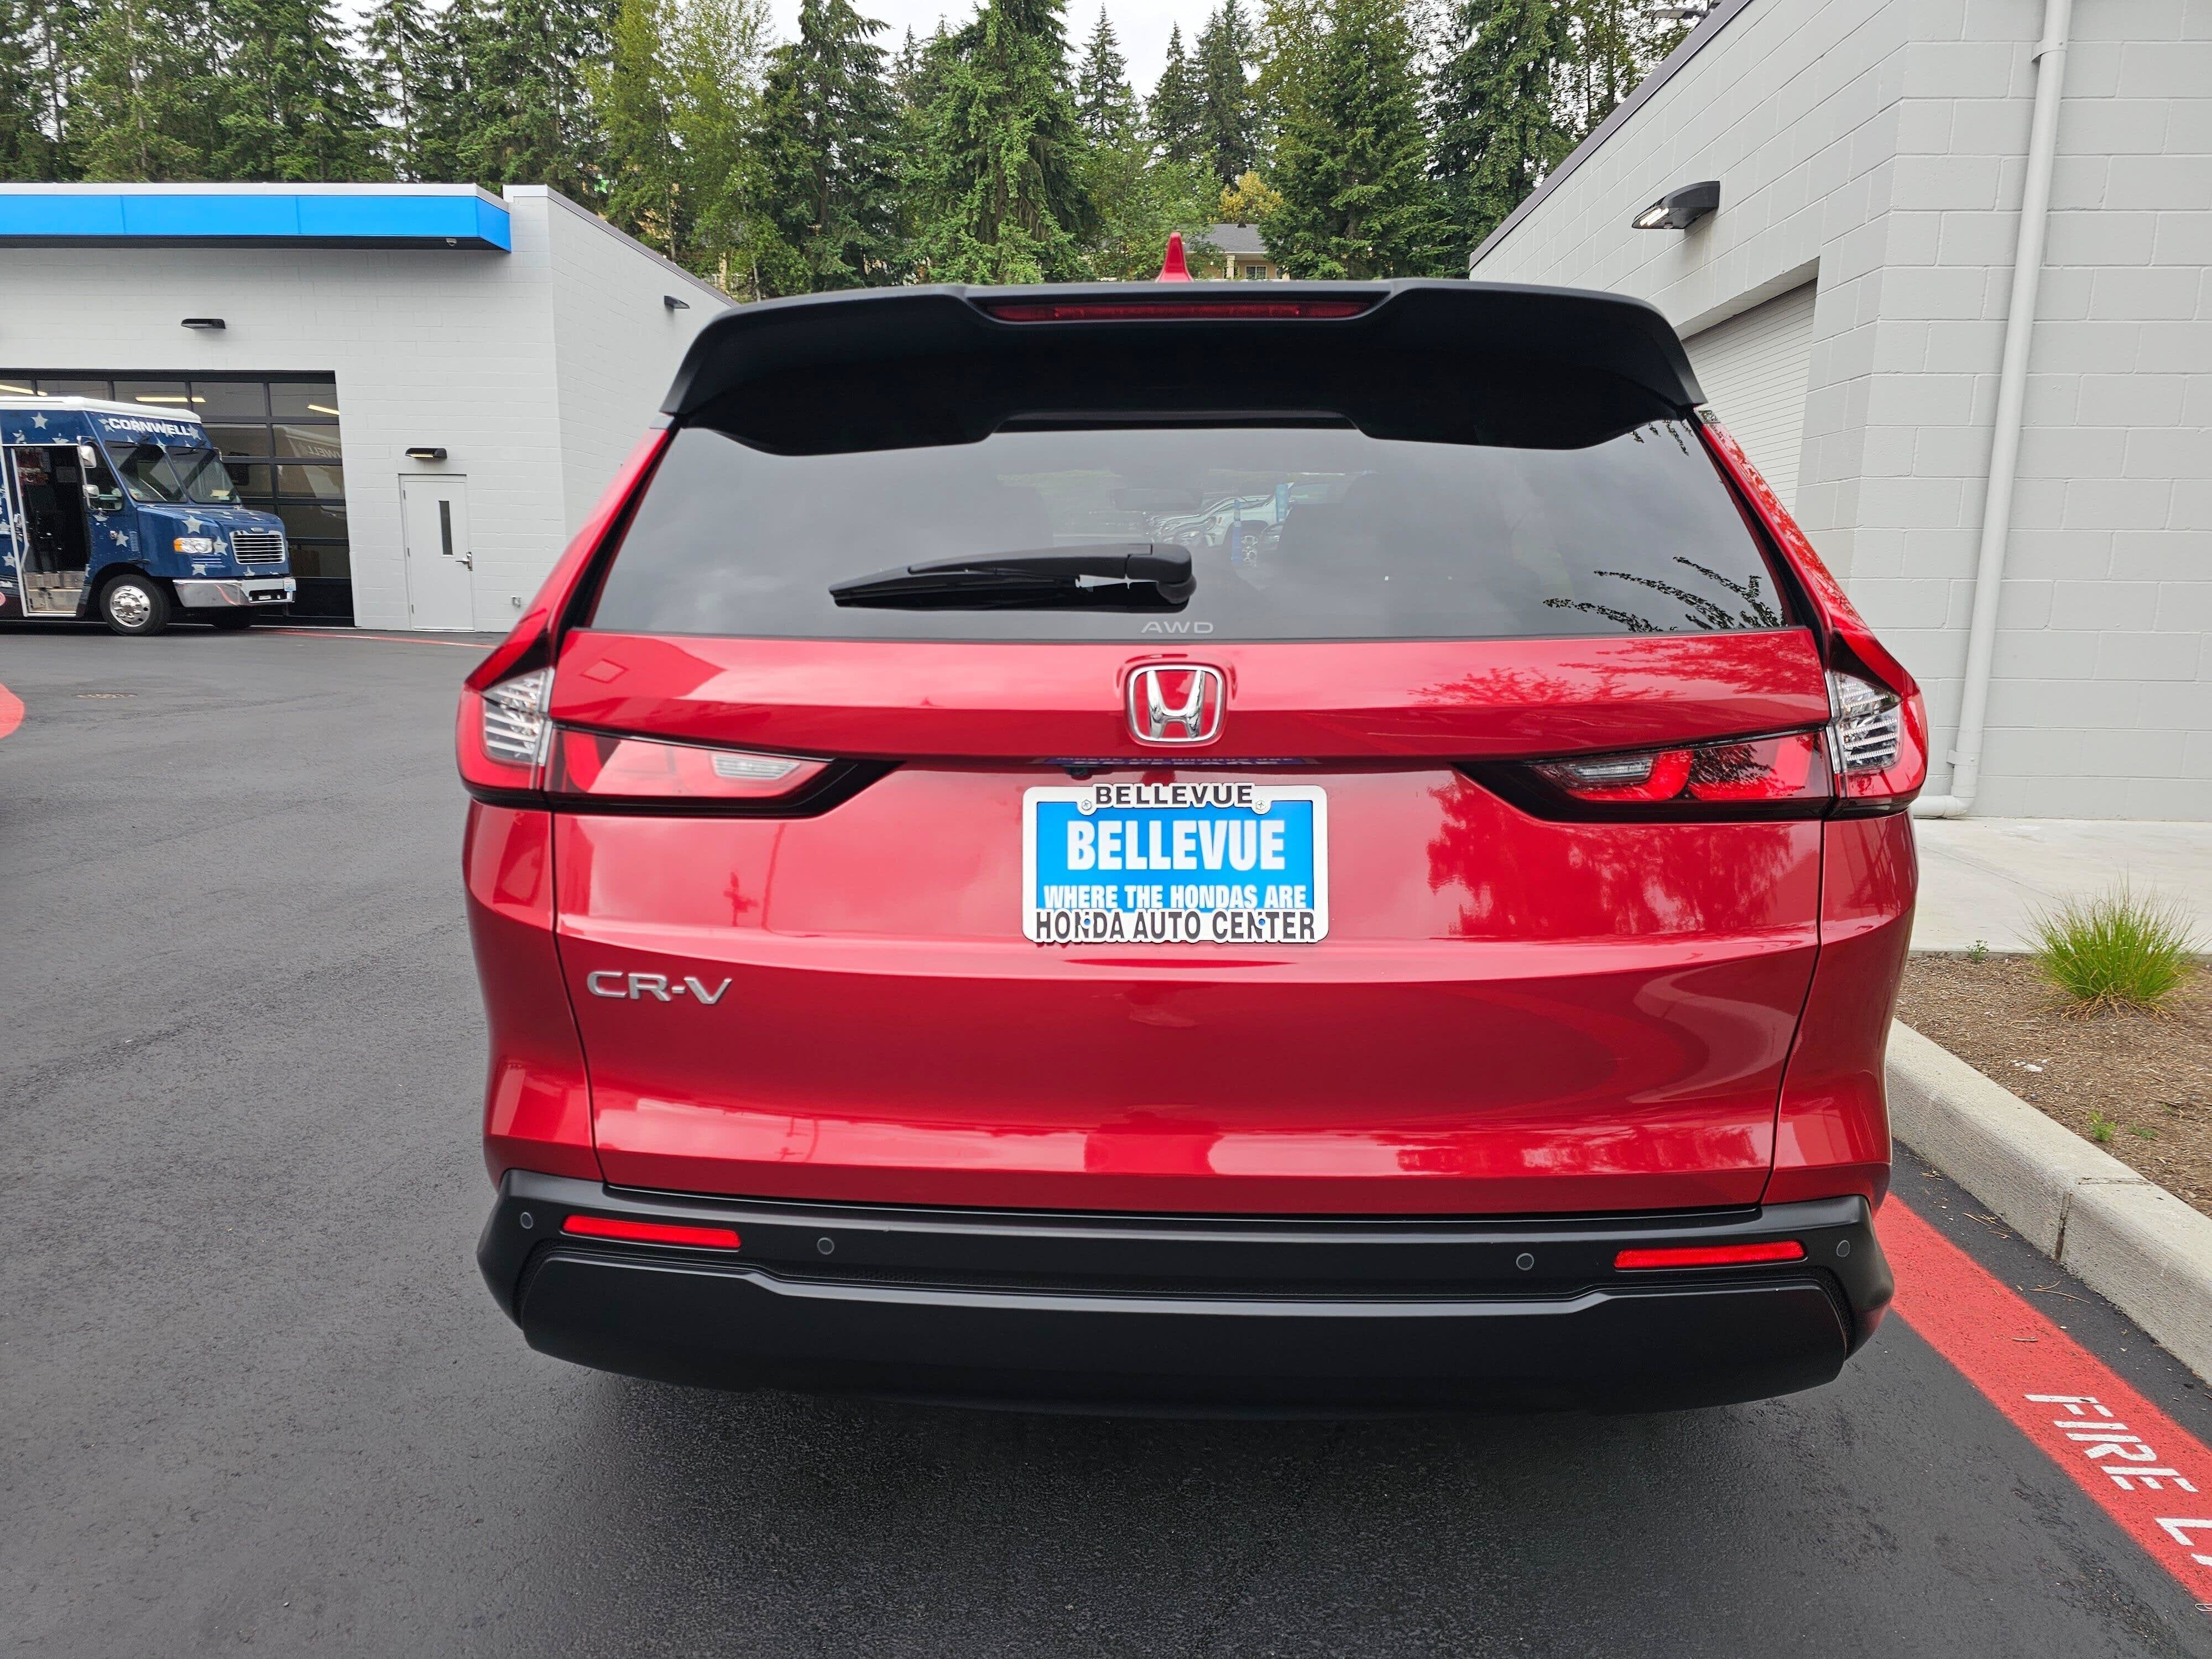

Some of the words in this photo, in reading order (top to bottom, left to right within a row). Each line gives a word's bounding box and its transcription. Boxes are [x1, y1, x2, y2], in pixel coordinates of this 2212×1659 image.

[108, 418, 190, 436] CORNWELL
[1141, 621, 1214, 634] AWD
[1095, 785, 1253, 805] BELLEVUE
[1067, 820, 1286, 871] BELLEVUE
[1044, 884, 1118, 909] WHERE
[1124, 884, 1164, 909] THE
[1170, 884, 1258, 909] HONDAS
[1263, 884, 1307, 909] ARE
[1036, 911, 1125, 940] HONDA
[1133, 911, 1201, 940] AUTO
[1212, 910, 1314, 940] CENTER
[586, 971, 733, 1005] CR-V
[2024, 1394, 2200, 1493] FIRE
